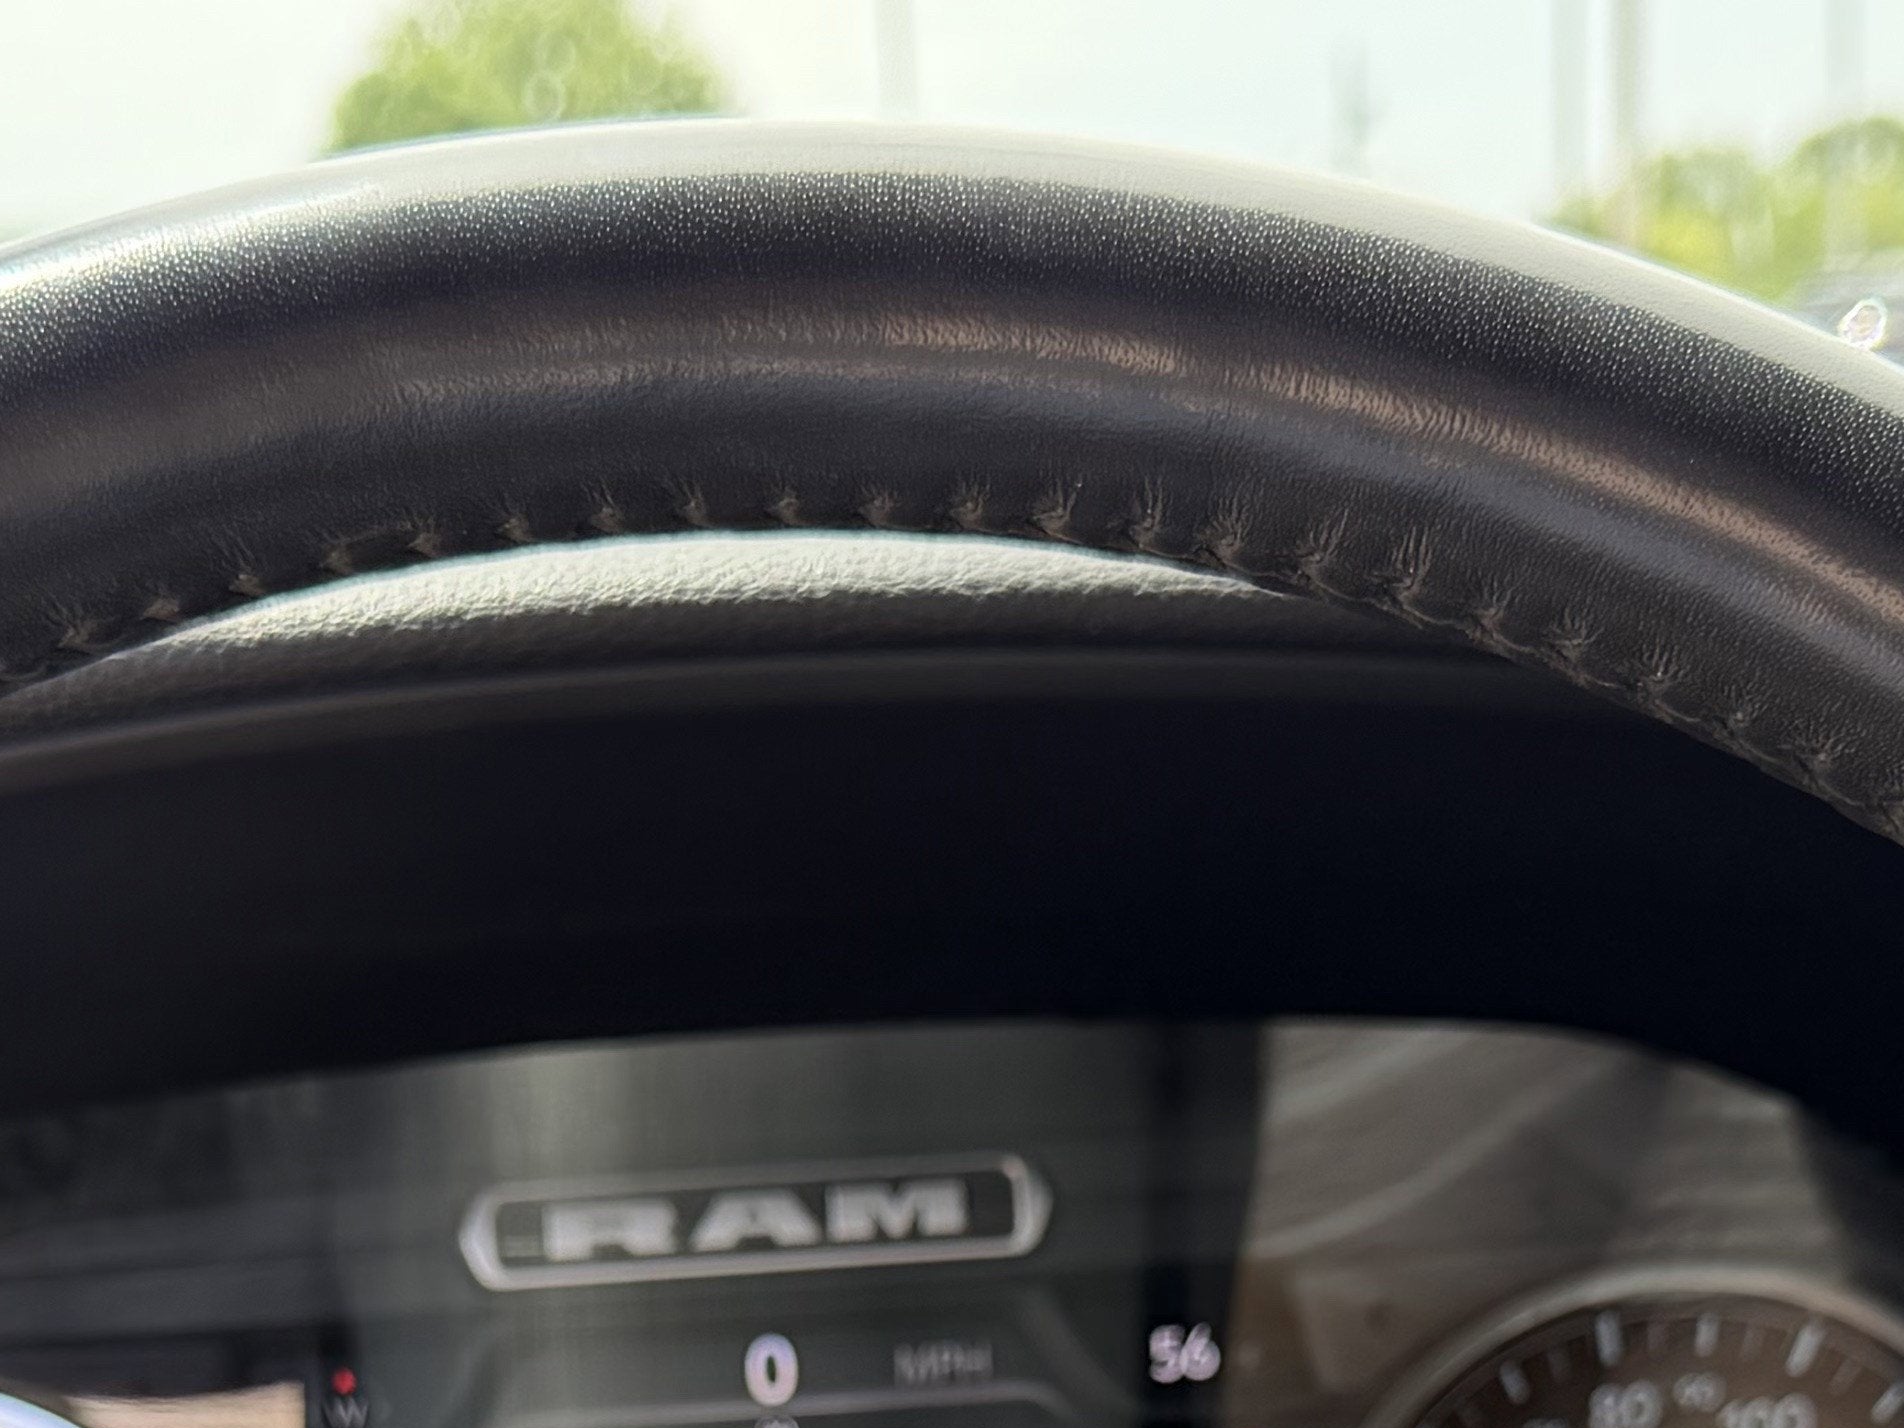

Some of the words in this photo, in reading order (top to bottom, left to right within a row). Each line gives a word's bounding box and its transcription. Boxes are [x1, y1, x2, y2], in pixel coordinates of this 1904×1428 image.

[540, 1178, 968, 1262] RAM
[744, 1333, 798, 1406] 0
[1149, 1322, 1221, 1384] 56
